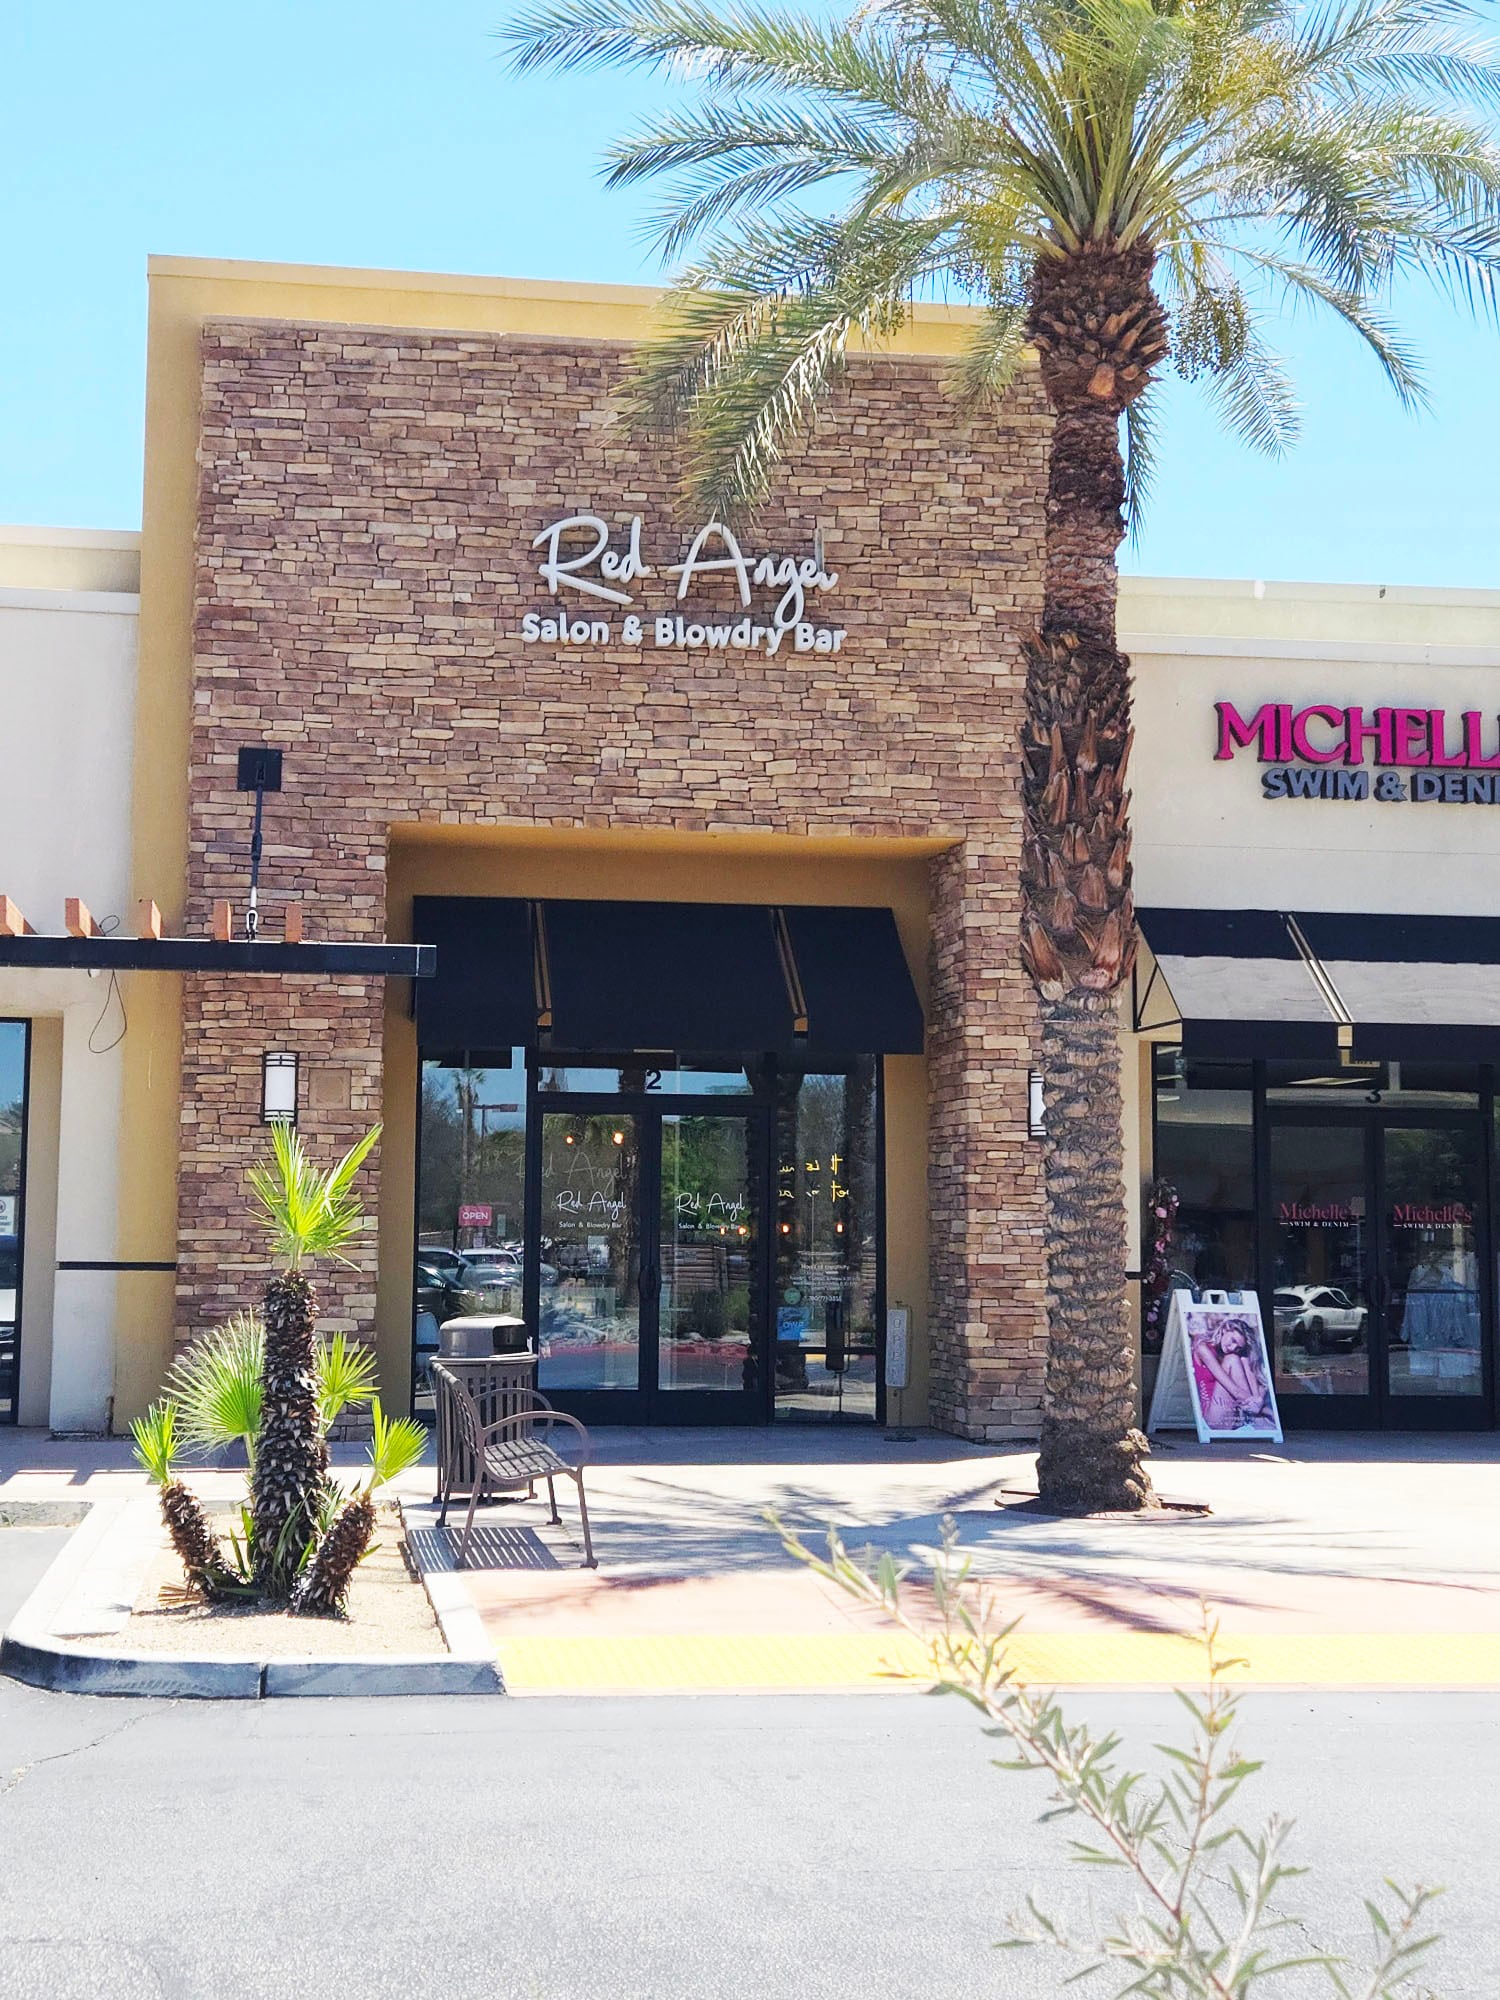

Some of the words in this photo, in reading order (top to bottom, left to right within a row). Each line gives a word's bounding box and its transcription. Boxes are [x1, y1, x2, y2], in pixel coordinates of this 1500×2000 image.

[533, 515, 650, 605] Red
[667, 522, 839, 628] Angel
[522, 612, 610, 646] Salon
[622, 614, 644, 646] &
[655, 616, 785, 657] Blowdry
[795, 622, 848, 652] Bar
[1213, 702, 1500, 769] MICHELL
[1261, 768, 1368, 800] SWIM
[1373, 771, 1408, 801] &
[646, 1069, 662, 1090] 2
[1365, 1088, 1382, 1104] 3
[462, 1211, 489, 1220] OPEN
[555, 1190, 583, 1215] Red
[587, 1191, 627, 1221] Angel
[674, 1192, 702, 1216] Red
[706, 1192, 746, 1222] Angel
